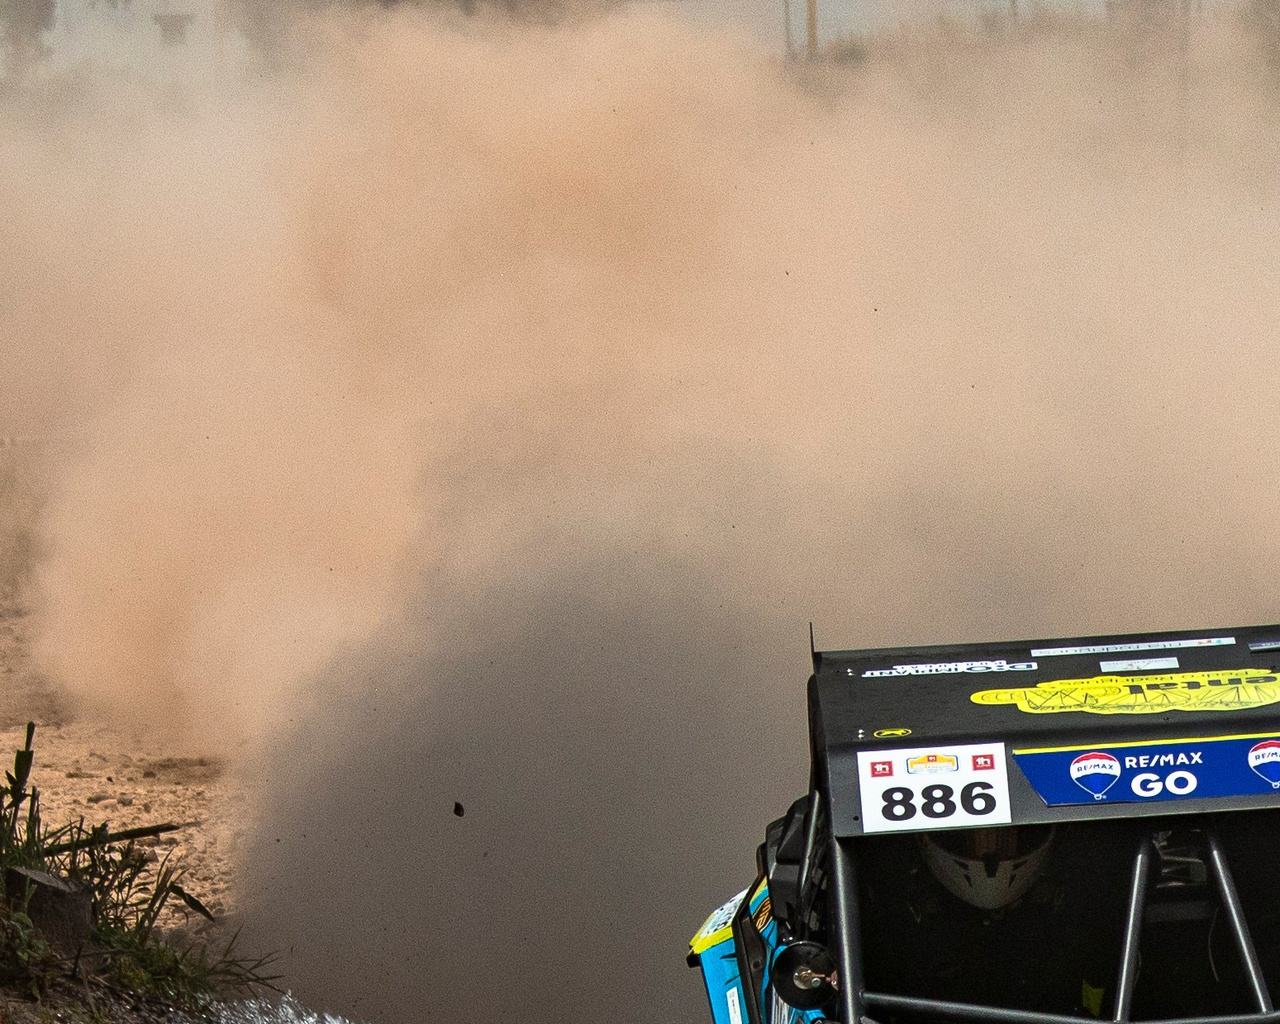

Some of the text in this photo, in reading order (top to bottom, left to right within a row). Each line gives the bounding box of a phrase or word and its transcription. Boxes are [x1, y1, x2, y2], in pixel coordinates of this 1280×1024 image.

[1077, 763, 1114, 774] RE/MAX
[1125, 752, 1203, 769] RE/MAX
[1131, 770, 1197, 797] GO
[881, 781, 997, 821] 886
